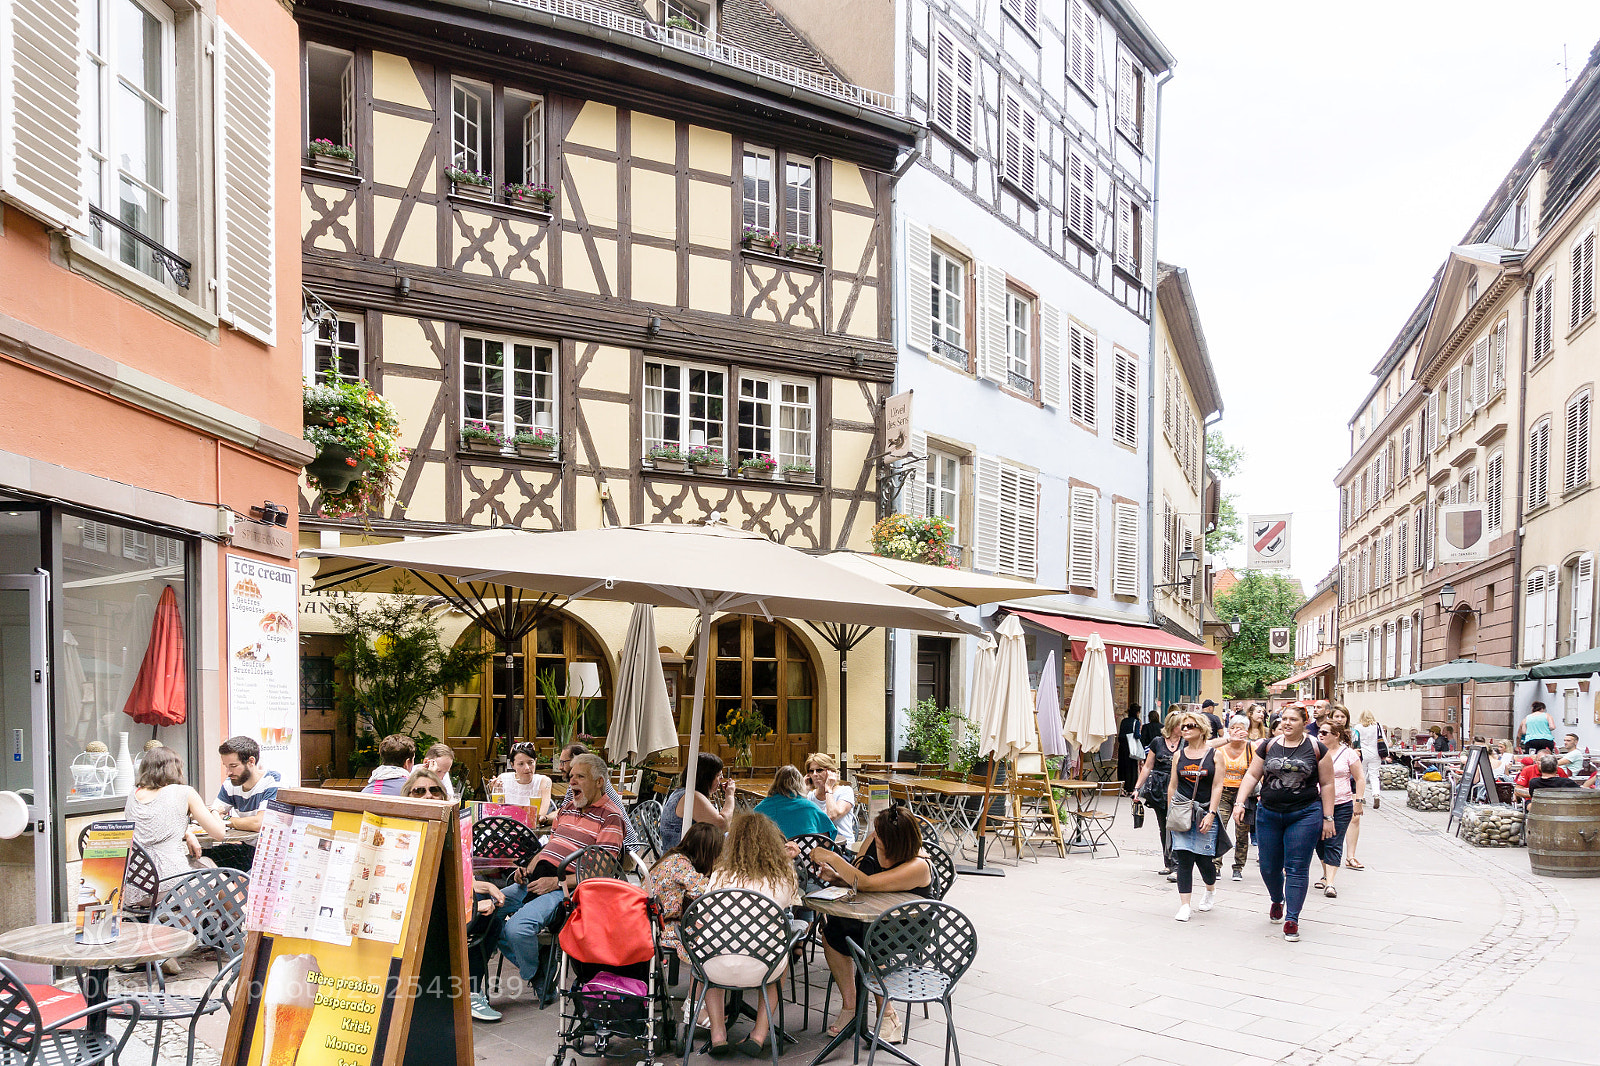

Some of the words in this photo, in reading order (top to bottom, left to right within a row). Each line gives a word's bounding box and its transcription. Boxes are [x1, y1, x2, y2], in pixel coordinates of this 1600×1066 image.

[234, 561, 255, 577] ICE
[257, 567, 292, 585] cream
[298, 601, 360, 615] ANCE
[1112, 646, 1151, 664] PLAISIRS
[1154, 651, 1192, 667] D'ALSACE
[306, 970, 335, 987] Bière
[336, 977, 380, 994] pression
[314, 992, 376, 1015] Desperados
[341, 1017, 372, 1035] Kriek
[325, 1035, 368, 1055] Monaco
